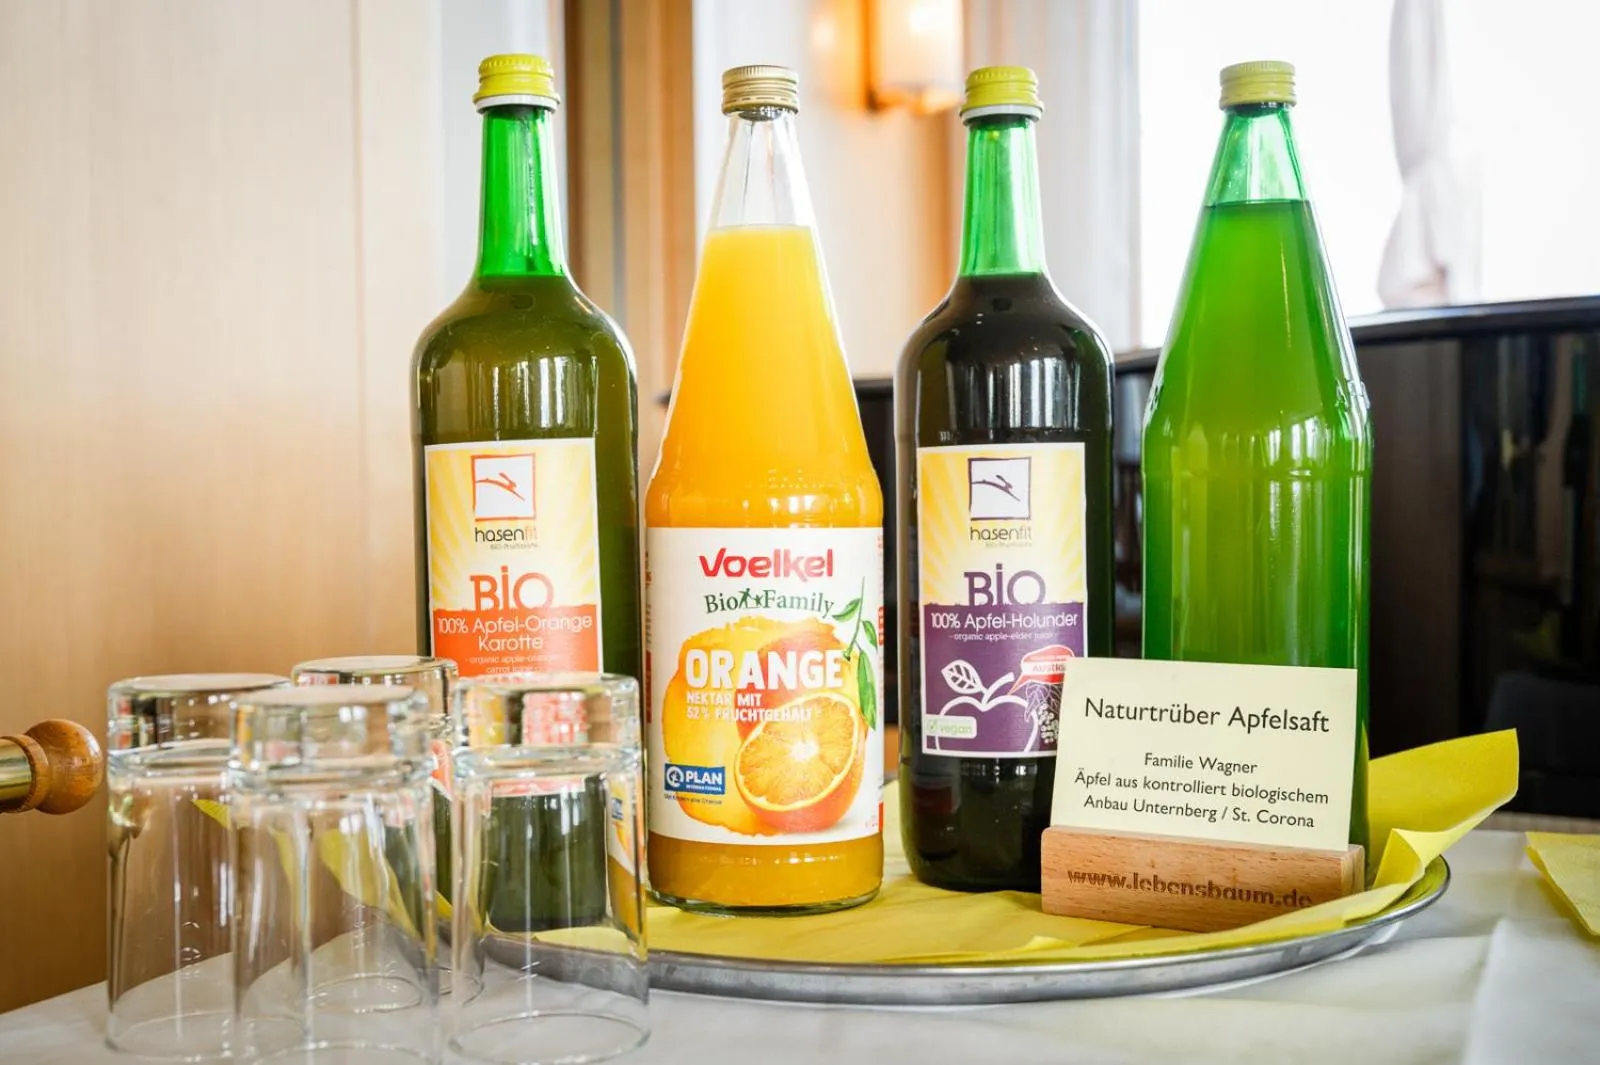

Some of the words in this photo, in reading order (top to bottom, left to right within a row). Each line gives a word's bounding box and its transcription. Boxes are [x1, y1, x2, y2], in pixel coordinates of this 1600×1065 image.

[970, 525, 1032, 541] hasenfit
[698, 547, 834, 582] Voelkel
[704, 594, 739, 614] Bio
[763, 589, 835, 618] Family
[437, 617, 469, 634] 100%
[473, 615, 592, 636] Apfel-Orange
[931, 612, 961, 629] 100%
[964, 612, 1078, 632] Apfel-Holunder
[478, 636, 544, 652] Karotte
[685, 649, 843, 690] ORANGE
[686, 691, 732, 705] NEKTAR
[737, 693, 762, 707] MIT
[715, 707, 813, 722] FRUCHTGEHALT
[1085, 697, 1220, 726] Naturtrüber
[1228, 706, 1330, 734] Apfelsaft
[1144, 752, 1194, 770] Familie
[1199, 755, 1258, 776] Wagner
[685, 770, 723, 786] PLAN
[1074, 767, 1111, 788] Äpfel
[1115, 778, 1138, 789] aus
[1143, 776, 1227, 796] kontrolliert
[1232, 783, 1329, 805] biologischem
[1084, 794, 1129, 812] Anbau
[1133, 798, 1217, 823] Unternberg
[1221, 805, 1228, 820] /
[1232, 806, 1251, 823] St.
[1257, 809, 1315, 828] Corona
[1067, 870, 1313, 908] www.lebensbaum.de
